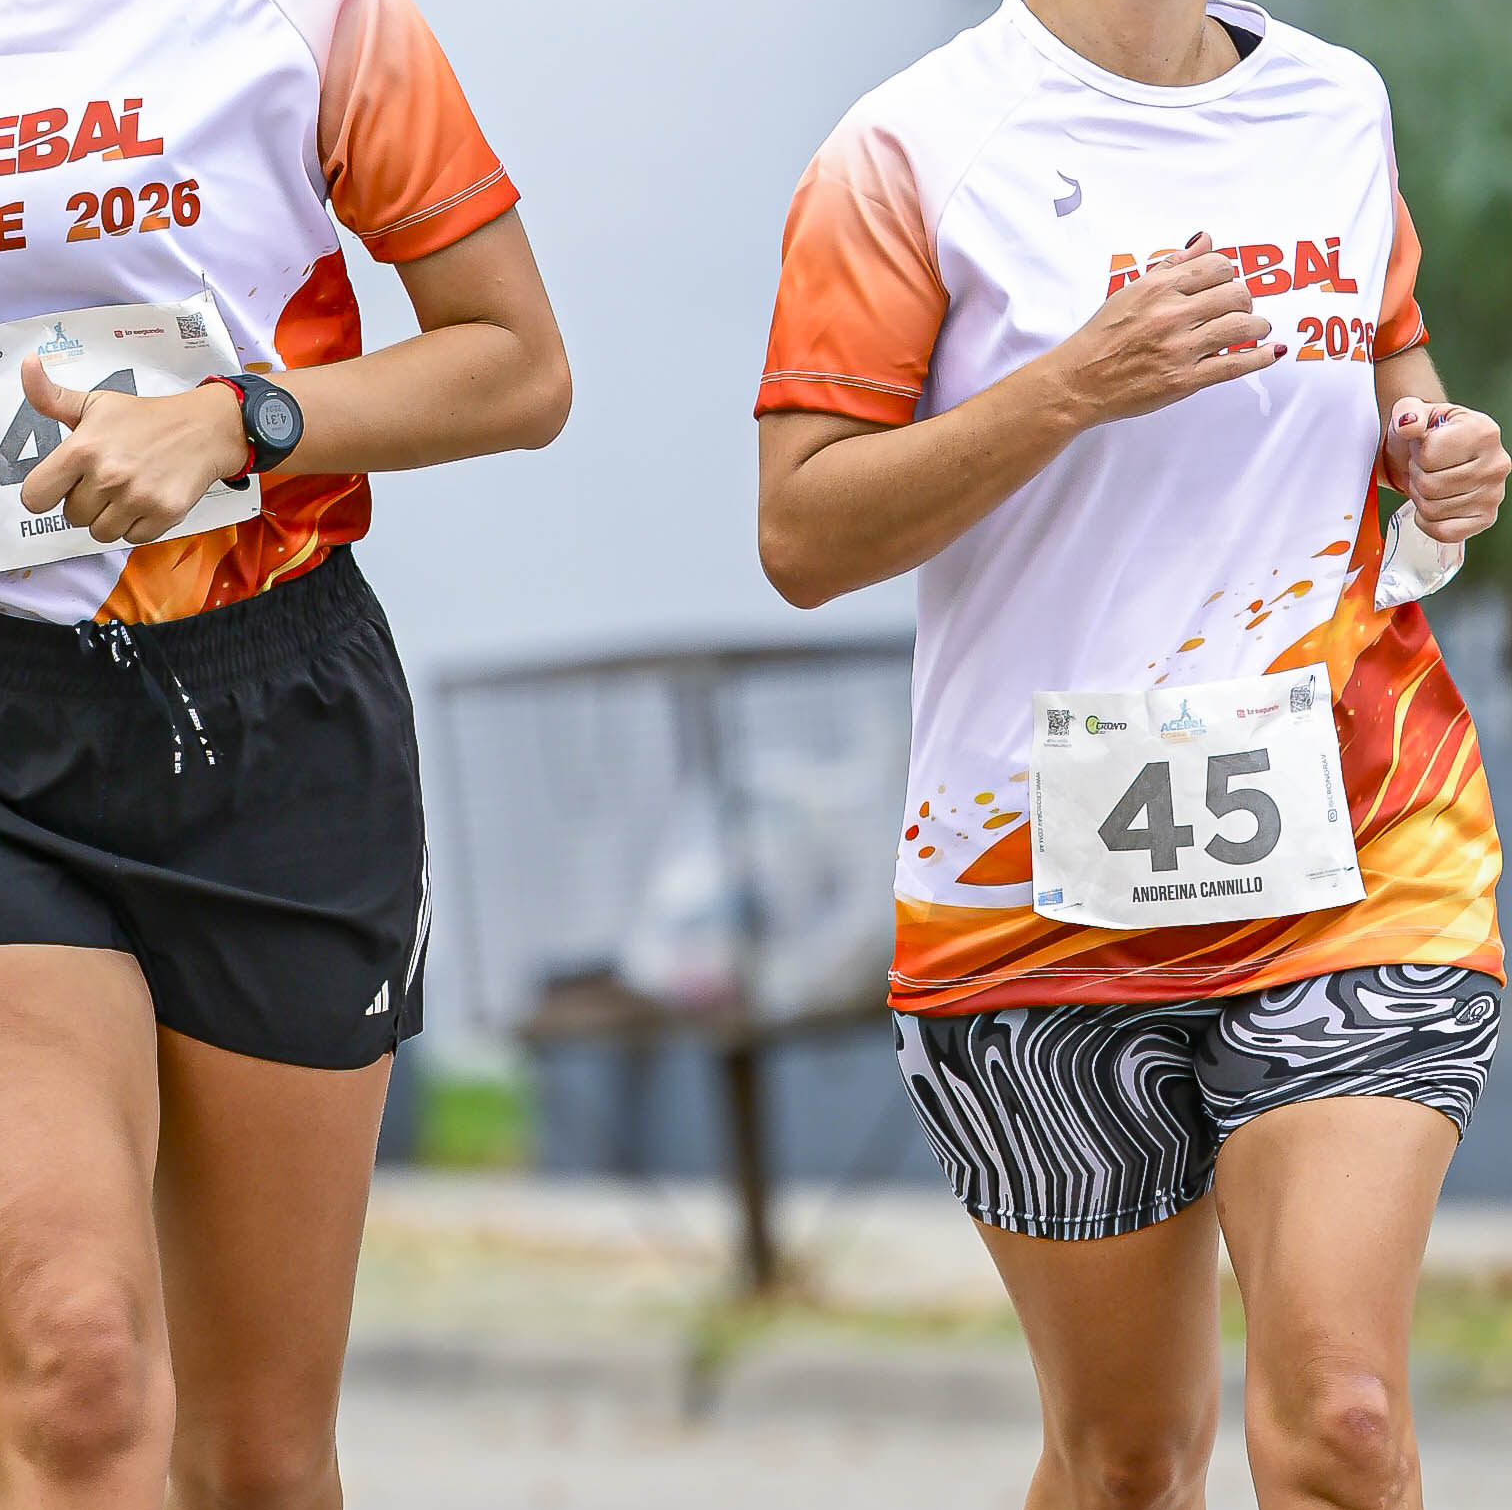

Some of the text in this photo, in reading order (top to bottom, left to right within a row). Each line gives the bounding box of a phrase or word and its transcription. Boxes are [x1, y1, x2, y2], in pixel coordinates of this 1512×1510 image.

[66, 178, 201, 243] 2026
[1098, 748, 1282, 872] 45
[1132, 876, 1263, 903] ANDREINA CANNILLO
